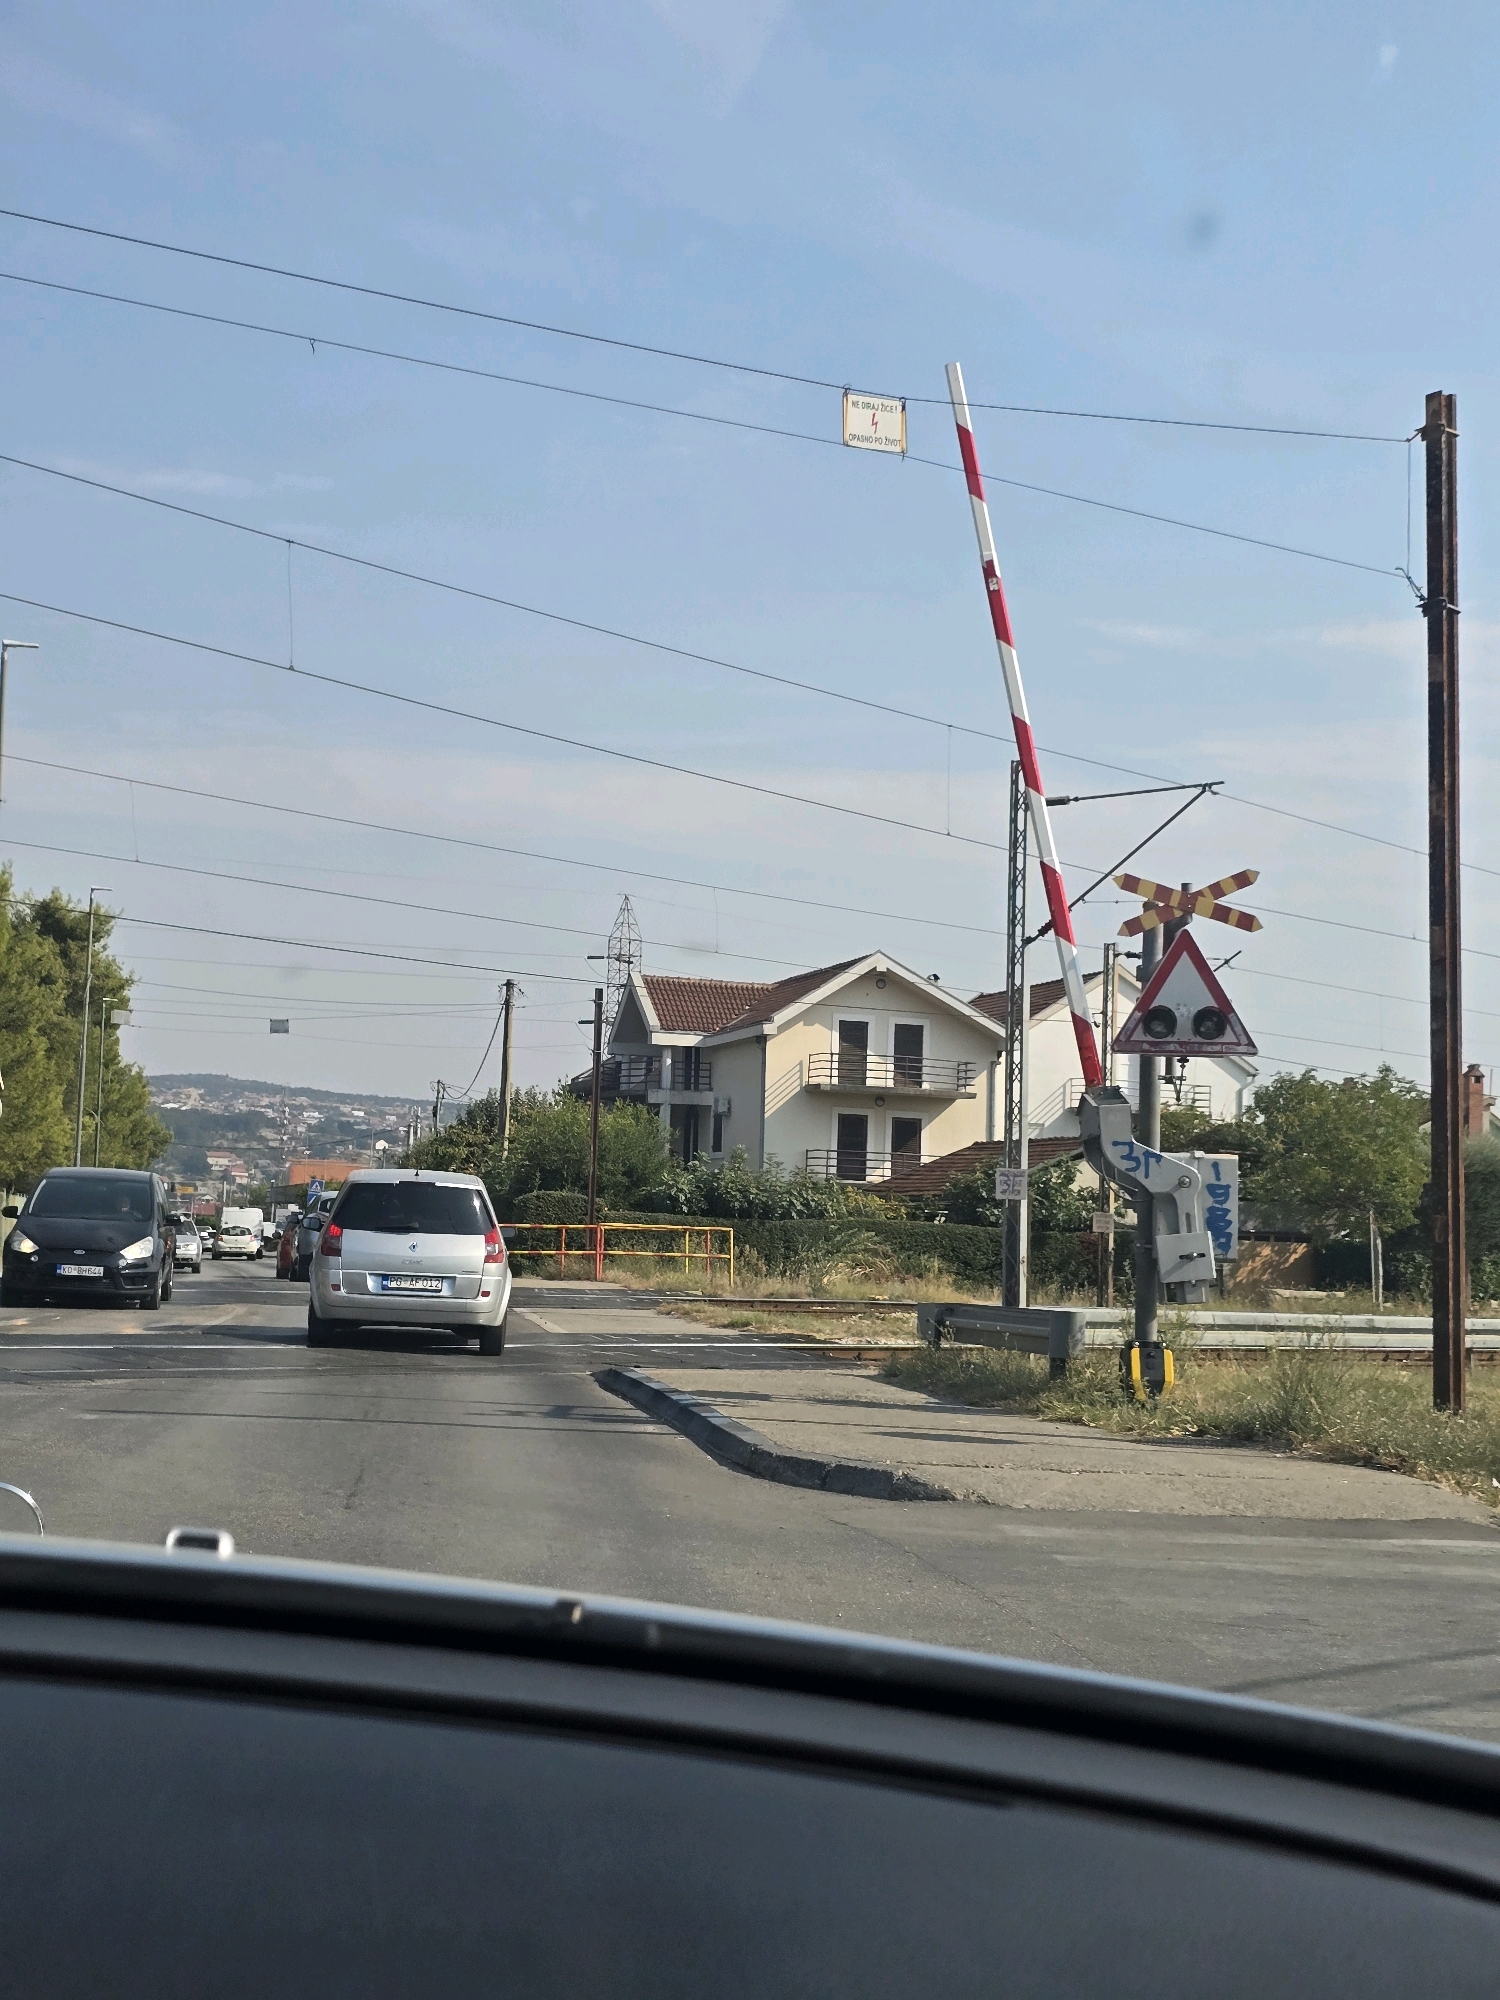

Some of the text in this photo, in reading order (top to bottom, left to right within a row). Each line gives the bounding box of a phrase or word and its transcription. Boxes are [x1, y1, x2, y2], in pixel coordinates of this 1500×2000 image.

[851, 400, 860, 409] NE
[861, 402, 879, 411] DIRAJ
[848, 433, 902, 447] OPASNO PO ŽIVOT
